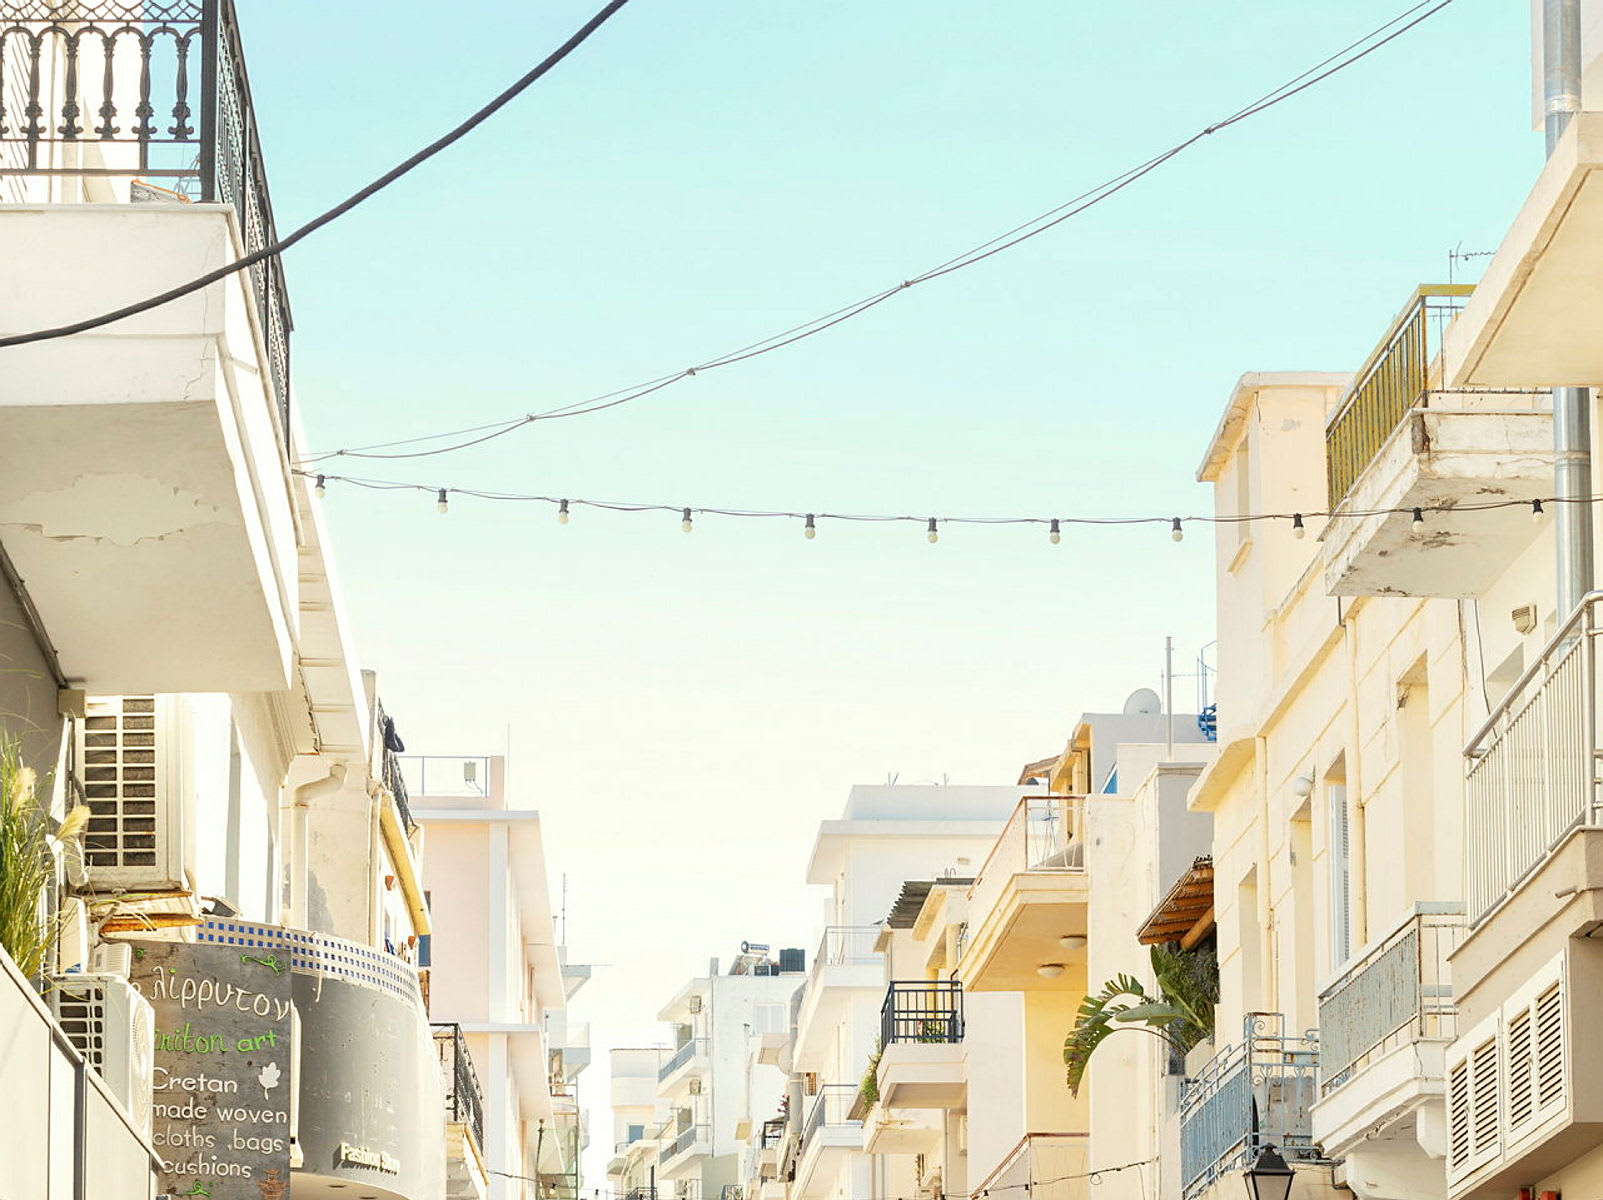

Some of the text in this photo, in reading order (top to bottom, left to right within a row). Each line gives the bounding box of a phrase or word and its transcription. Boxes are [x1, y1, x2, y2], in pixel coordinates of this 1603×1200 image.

[237, 1029, 278, 1052] art
[152, 1066, 238, 1094] Cretan
[216, 1105, 288, 1124] woven
[153, 1123, 217, 1148] cloths
[162, 1153, 252, 1178] cushions
